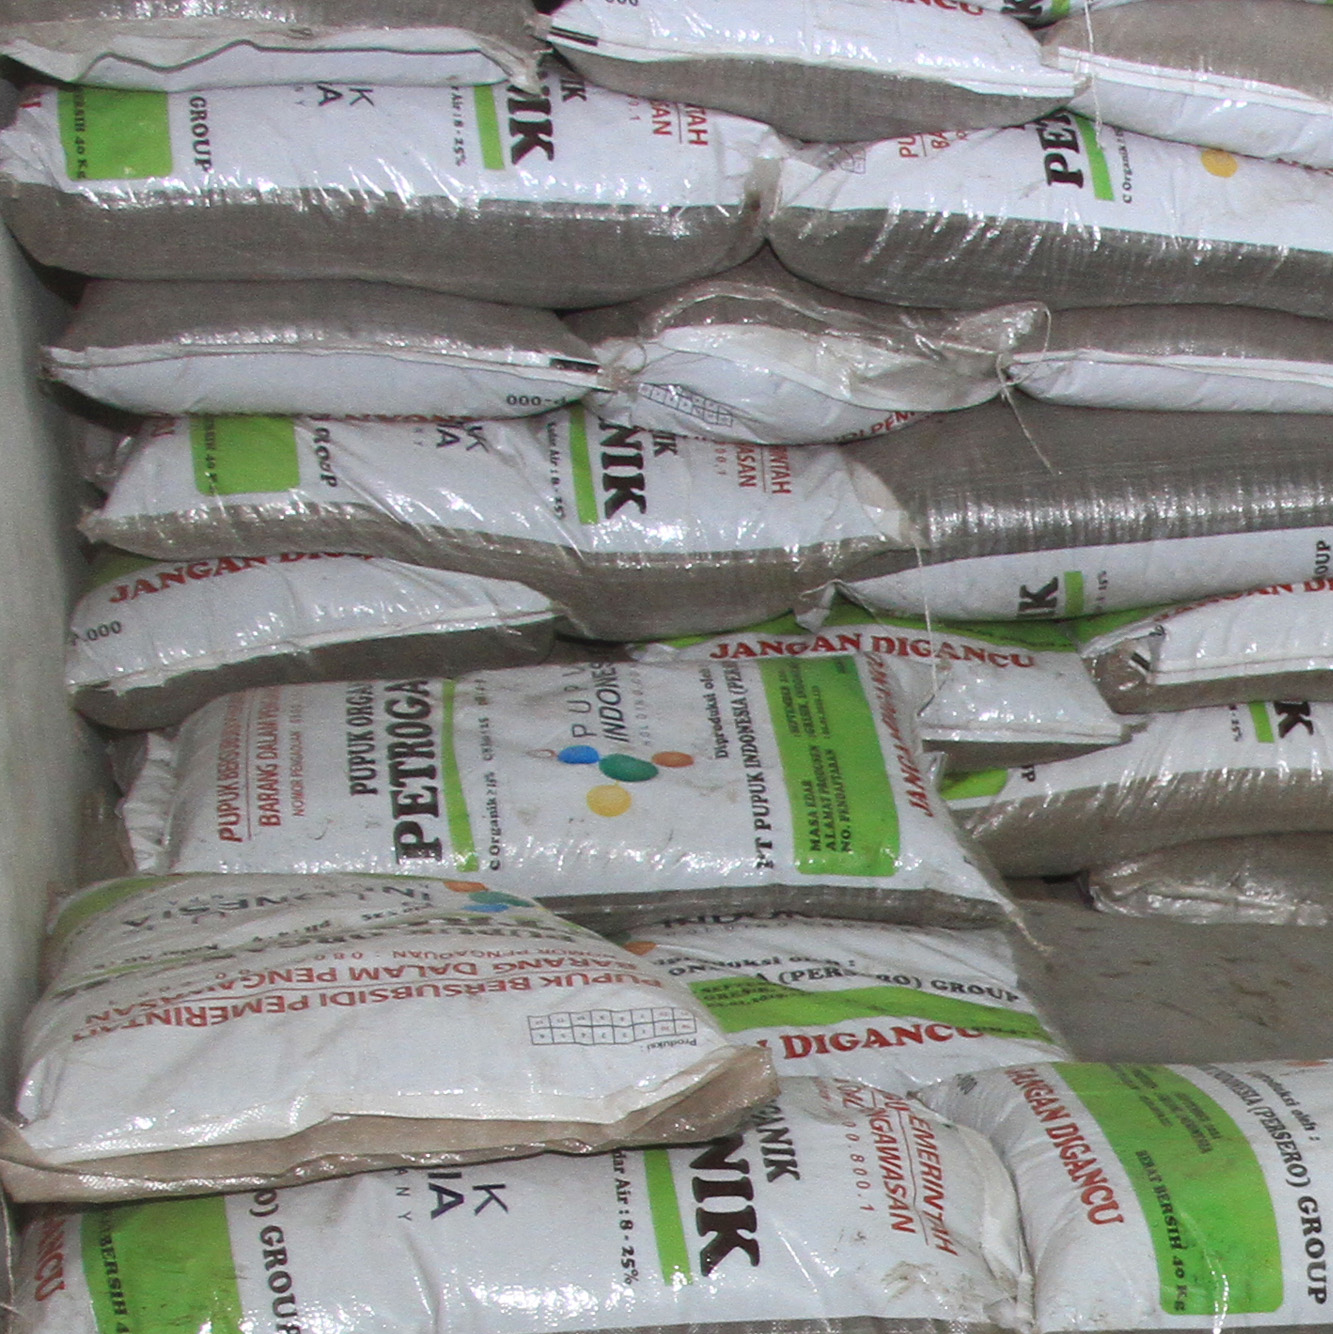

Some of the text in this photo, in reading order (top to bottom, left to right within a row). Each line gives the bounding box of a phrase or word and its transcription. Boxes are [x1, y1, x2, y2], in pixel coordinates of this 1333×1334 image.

[189, 96, 213, 172] GROUP
[109, 556, 267, 604] JANGAN
[709, 633, 1036, 668] JANGAN DIGANCU
[256, 763, 282, 827] BARANG
[348, 731, 378, 796] PUPUK
[383, 677, 443, 865] PETROGA
[216, 780, 243, 843] PUPUK
[746, 772, 773, 831] PUPUK
[320, 976, 532, 1007] BERSUBSIDI
[349, 962, 478, 984] DALAM
[1004, 1066, 1126, 1227] JANGAN DIGANCU
[1154, 1184, 1187, 1251] BERSIH
[1171, 1254, 1186, 1279] 40
[1298, 1195, 1328, 1305] GROUP
[620, 1245, 640, 1286] 25%
